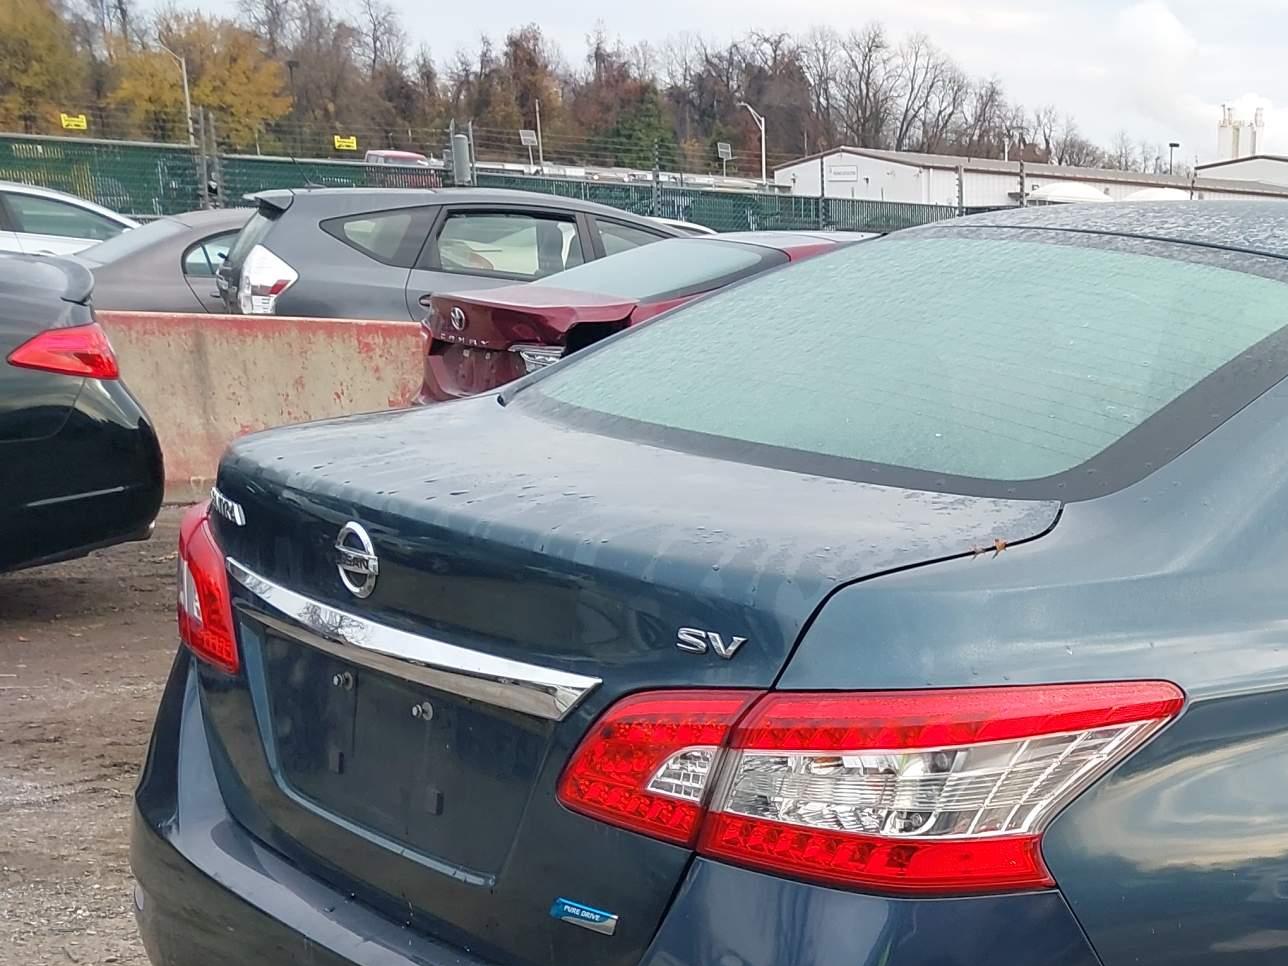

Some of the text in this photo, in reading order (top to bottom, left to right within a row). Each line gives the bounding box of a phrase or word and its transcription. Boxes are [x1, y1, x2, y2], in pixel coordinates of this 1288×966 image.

[676, 627, 747, 660] SV
[563, 905, 601, 922] PURE DRIVE
